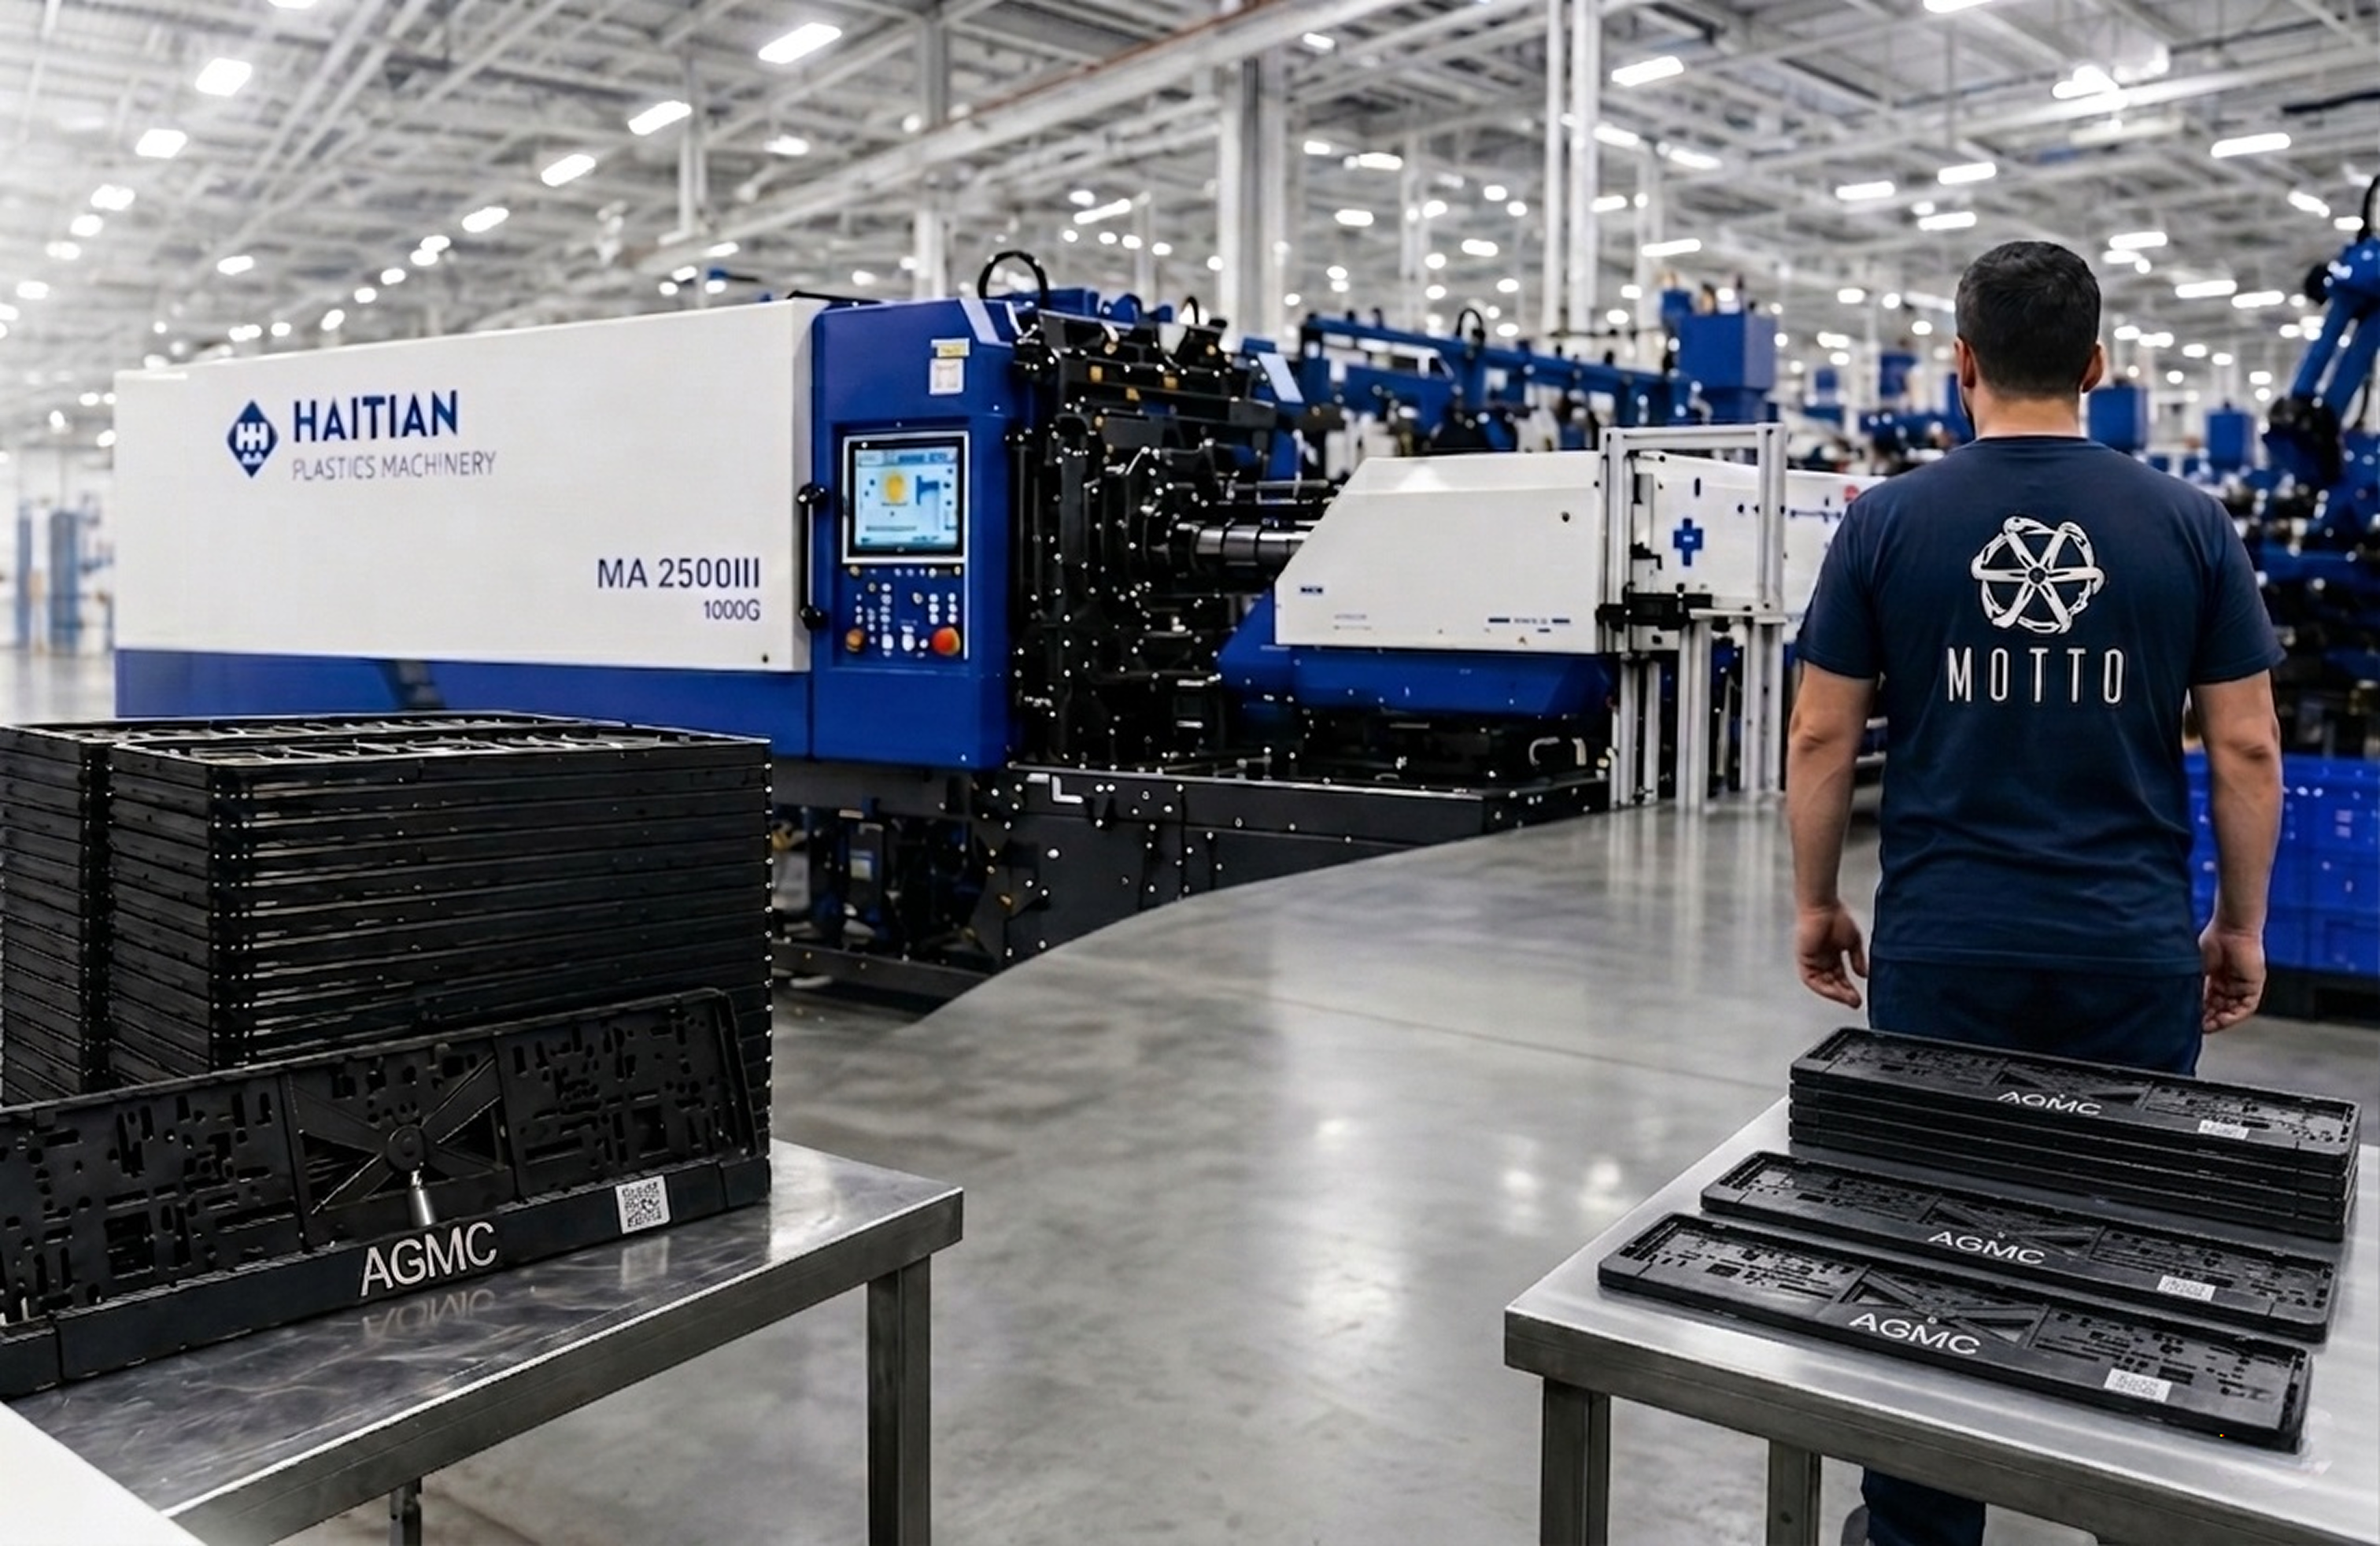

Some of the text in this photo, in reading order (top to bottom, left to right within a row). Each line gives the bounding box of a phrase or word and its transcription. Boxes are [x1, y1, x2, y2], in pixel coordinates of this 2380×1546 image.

[294, 390, 458, 442] HAITIAN
[292, 450, 497, 481] PLASTICS MACHINERY
[598, 557, 759, 589] MA 2500III
[704, 598, 761, 622] 1000G
[1947, 646, 2124, 705] MOTTO
[360, 1221, 497, 1297] AGMC
[1927, 1231, 2046, 1264] AGMC
[1848, 1312, 1981, 1355] AGMC
